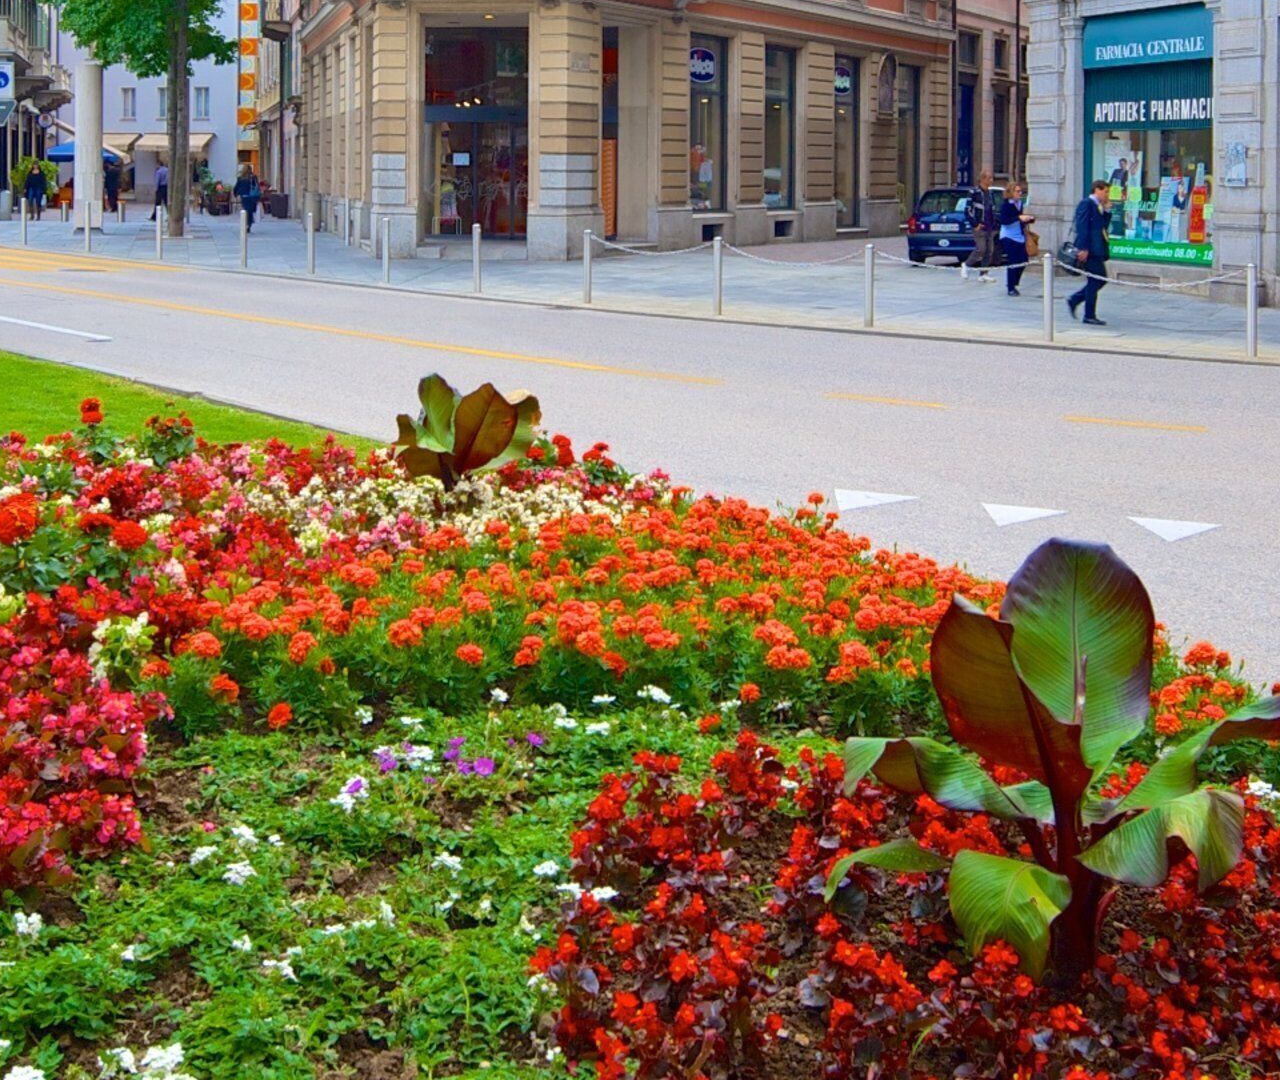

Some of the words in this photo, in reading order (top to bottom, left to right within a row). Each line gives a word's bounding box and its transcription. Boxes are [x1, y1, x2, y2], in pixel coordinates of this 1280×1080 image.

[1096, 42, 1144, 62] FARMACIA
[1147, 36, 1205, 56] CENTRALE
[1094, 101, 1146, 123] APOTHEKE
[1150, 97, 1213, 121] PHARMACI
